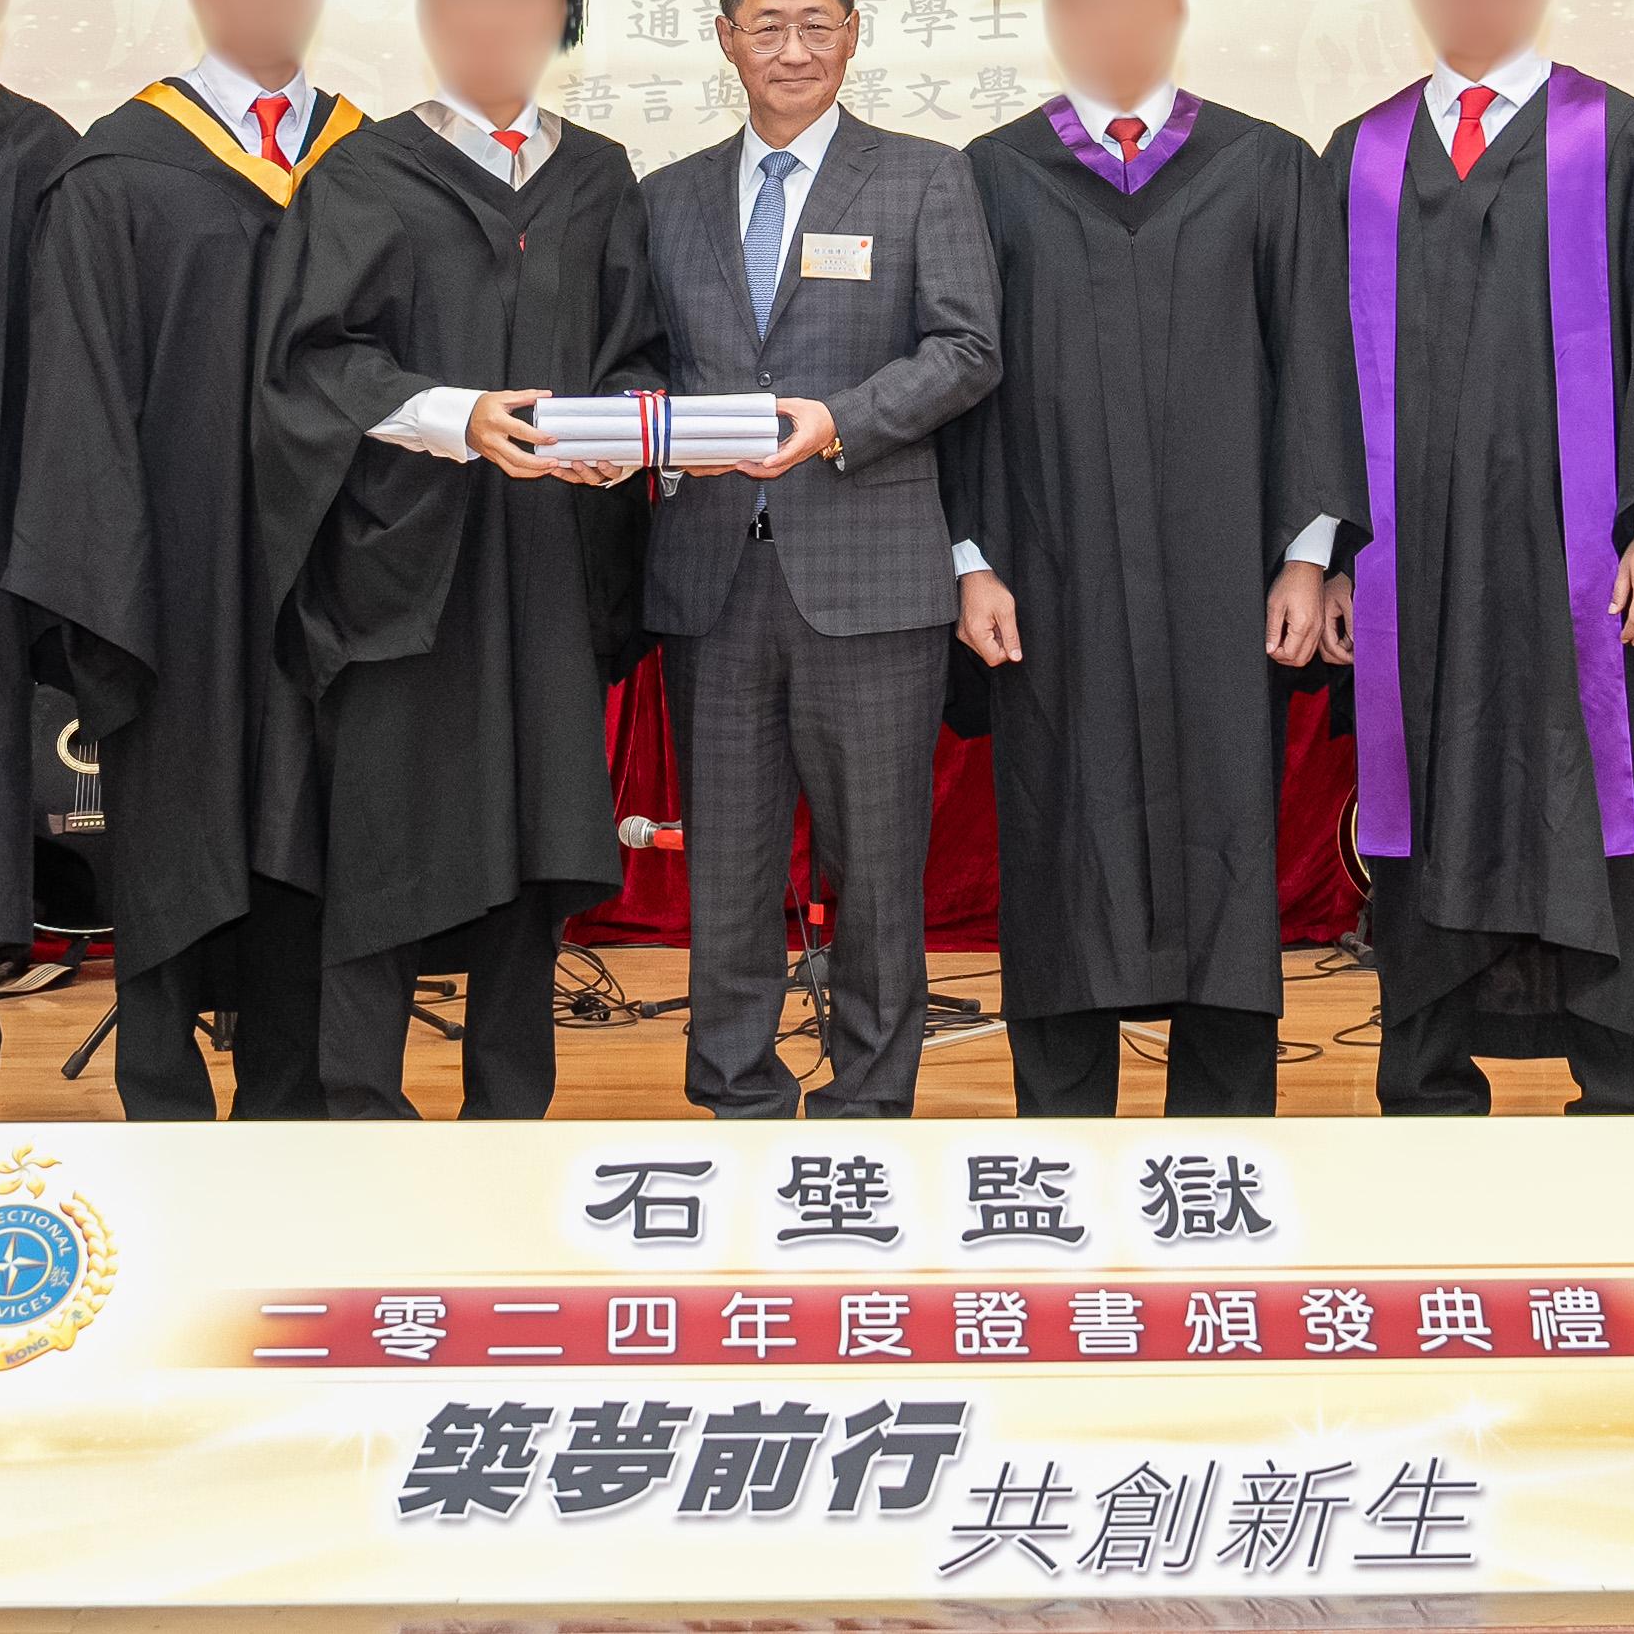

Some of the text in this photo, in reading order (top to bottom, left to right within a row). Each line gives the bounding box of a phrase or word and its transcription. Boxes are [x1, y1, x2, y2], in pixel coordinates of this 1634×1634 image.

[584, 1154, 1274, 1244] 石壁監獄
[4, 1336, 50, 1365] KONG
[253, 1286, 1612, 1362] 二零二四年度證書頒發典禮
[398, 1399, 968, 1516] 築夢前行
[938, 1456, 1480, 1575] 共創新生
